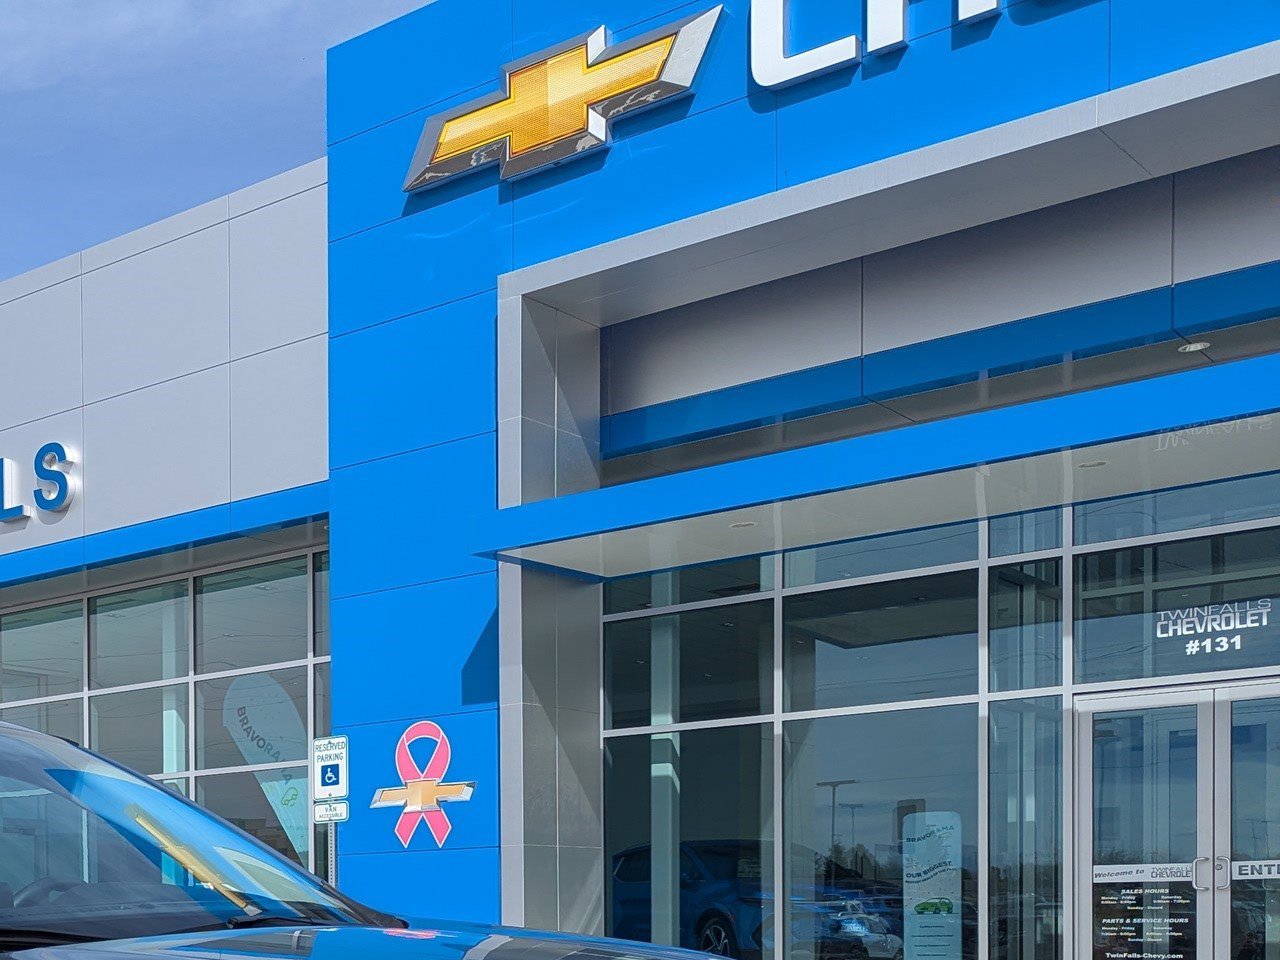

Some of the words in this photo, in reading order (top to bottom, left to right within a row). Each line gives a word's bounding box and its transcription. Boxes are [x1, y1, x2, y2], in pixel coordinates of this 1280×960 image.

[1157, 598, 1272, 621] TWINFALLS
[1156, 608, 1272, 638] CHEVROLET
[1185, 634, 1242, 655] #131
[315, 741, 346, 752] RESERVED
[316, 752, 344, 763] PARKING
[1094, 870, 1133, 879] Welcome
[1151, 869, 1192, 879] CHEVROLE
